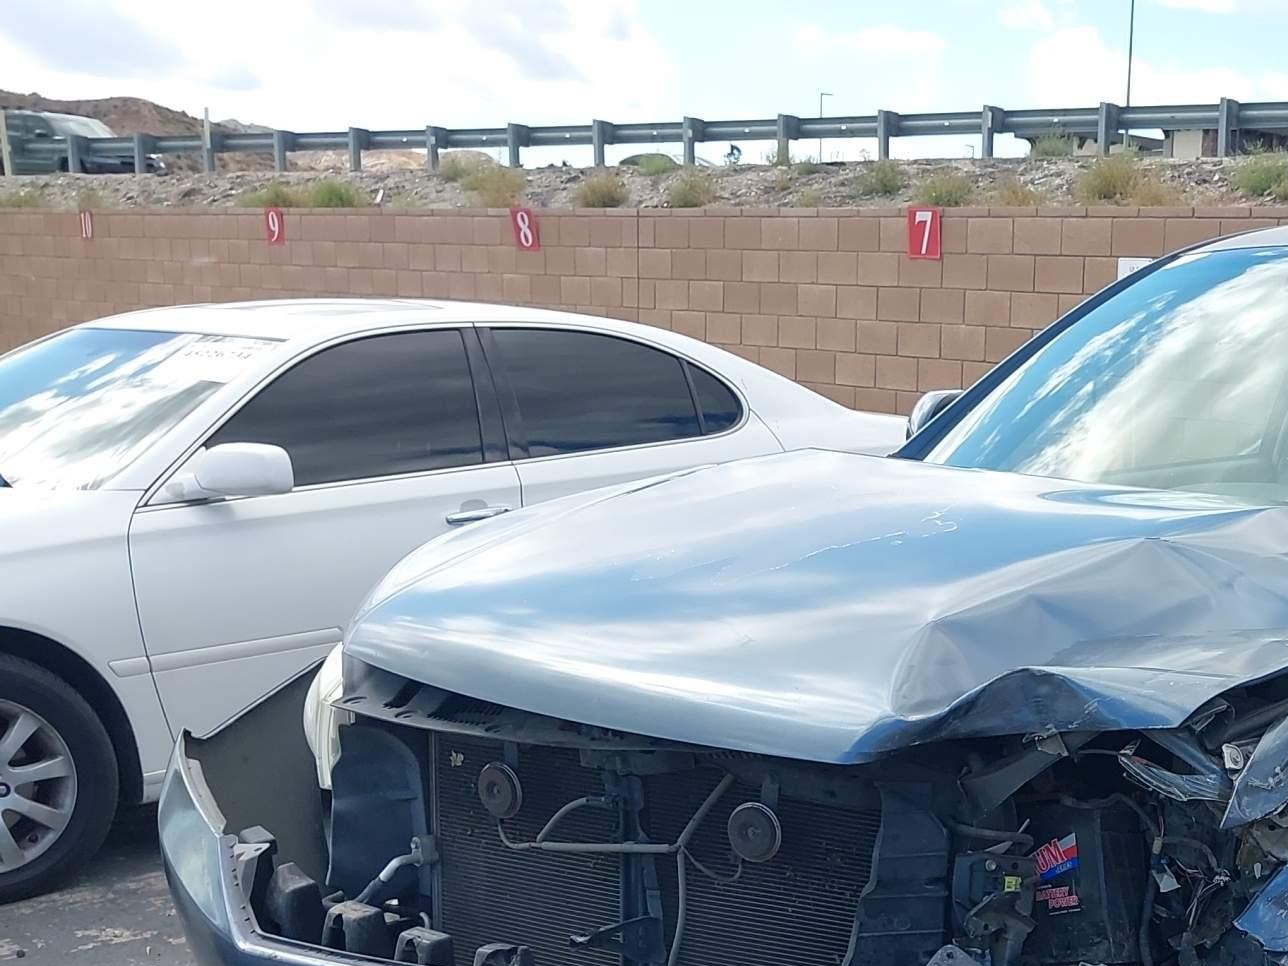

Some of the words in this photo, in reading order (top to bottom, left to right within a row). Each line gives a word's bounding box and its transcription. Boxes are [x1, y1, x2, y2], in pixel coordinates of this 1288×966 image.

[80, 210, 93, 239] 10
[268, 211, 279, 242] 9
[516, 211, 533, 248] 8
[914, 211, 933, 255] 7
